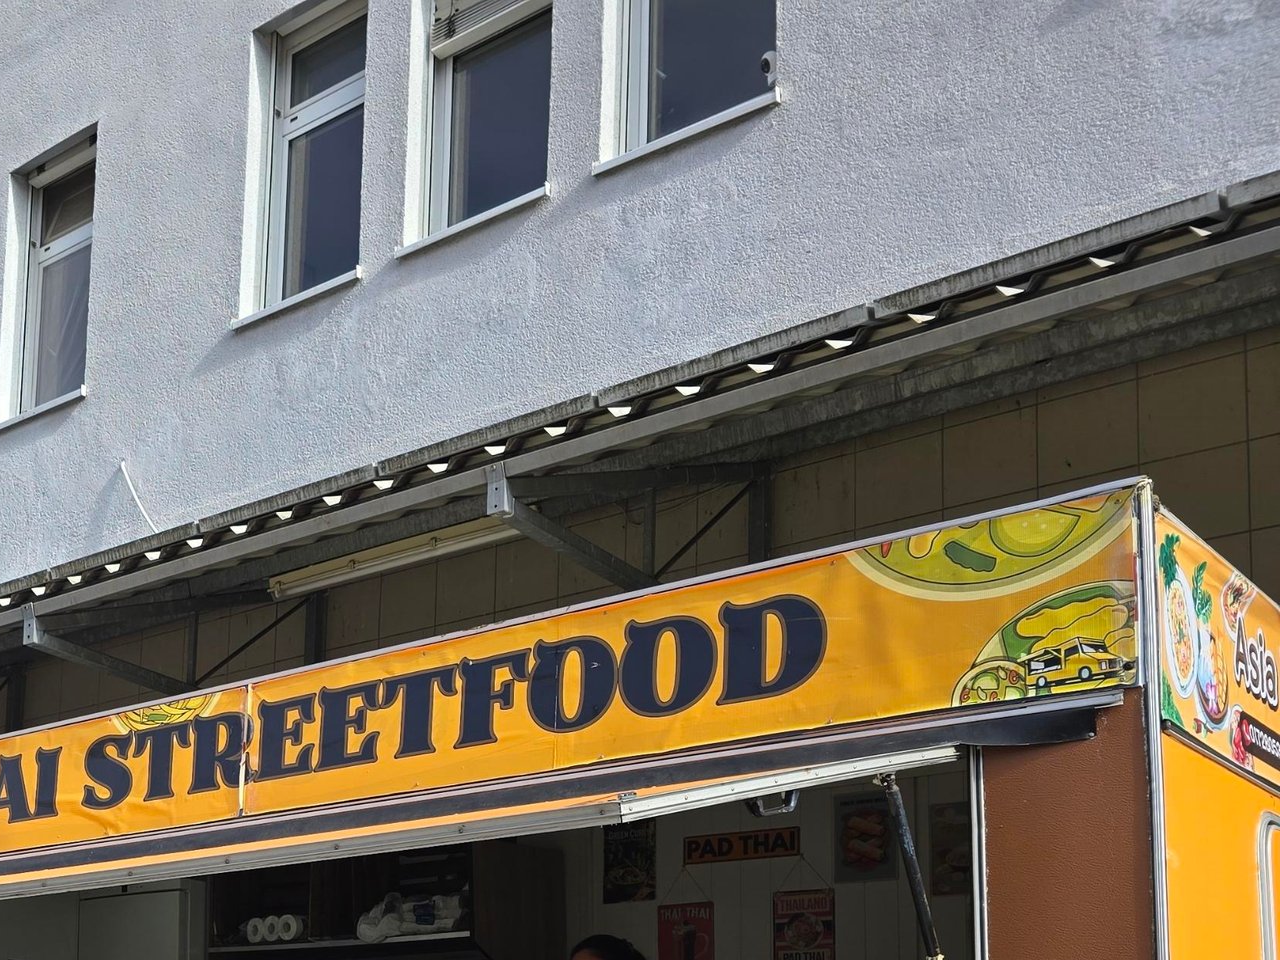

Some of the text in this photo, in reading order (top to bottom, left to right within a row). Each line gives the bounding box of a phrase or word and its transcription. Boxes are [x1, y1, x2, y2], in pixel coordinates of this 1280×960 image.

[1235, 613, 1278, 710] Asia
[83, 593, 828, 811] STREETFOOD
[687, 830, 796, 860] PAD THAI
[660, 908, 710, 921] THAI THAI
[780, 896, 828, 912] THAILAND
